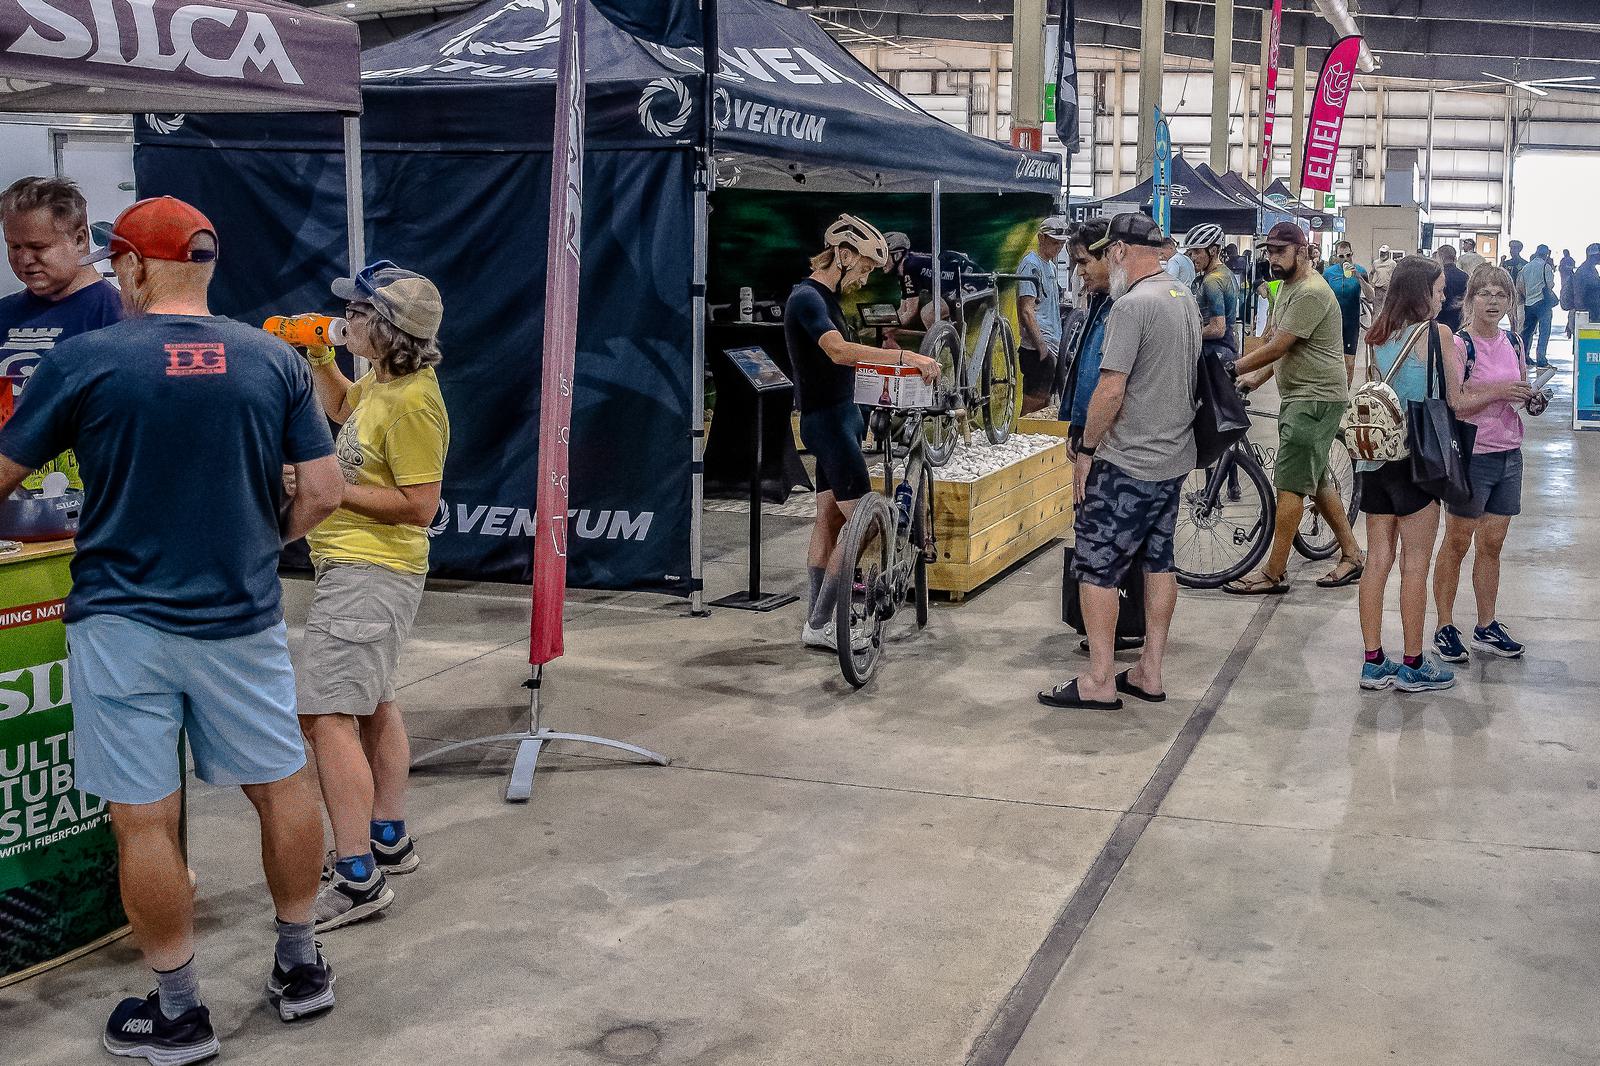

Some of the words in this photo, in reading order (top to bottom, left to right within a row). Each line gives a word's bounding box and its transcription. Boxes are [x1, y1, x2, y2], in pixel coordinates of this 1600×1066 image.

[6, 0, 305, 85] SILCA
[734, 99, 826, 142] VENTUM
[1308, 116, 1340, 179] ELIEL
[1586, 352, 1600, 362] FR
[56, 500, 80, 510] SILCA
[457, 503, 654, 541] VENUM
[0, 841, 31, 858] WITH
[122, 1018, 153, 1034] HOKA
